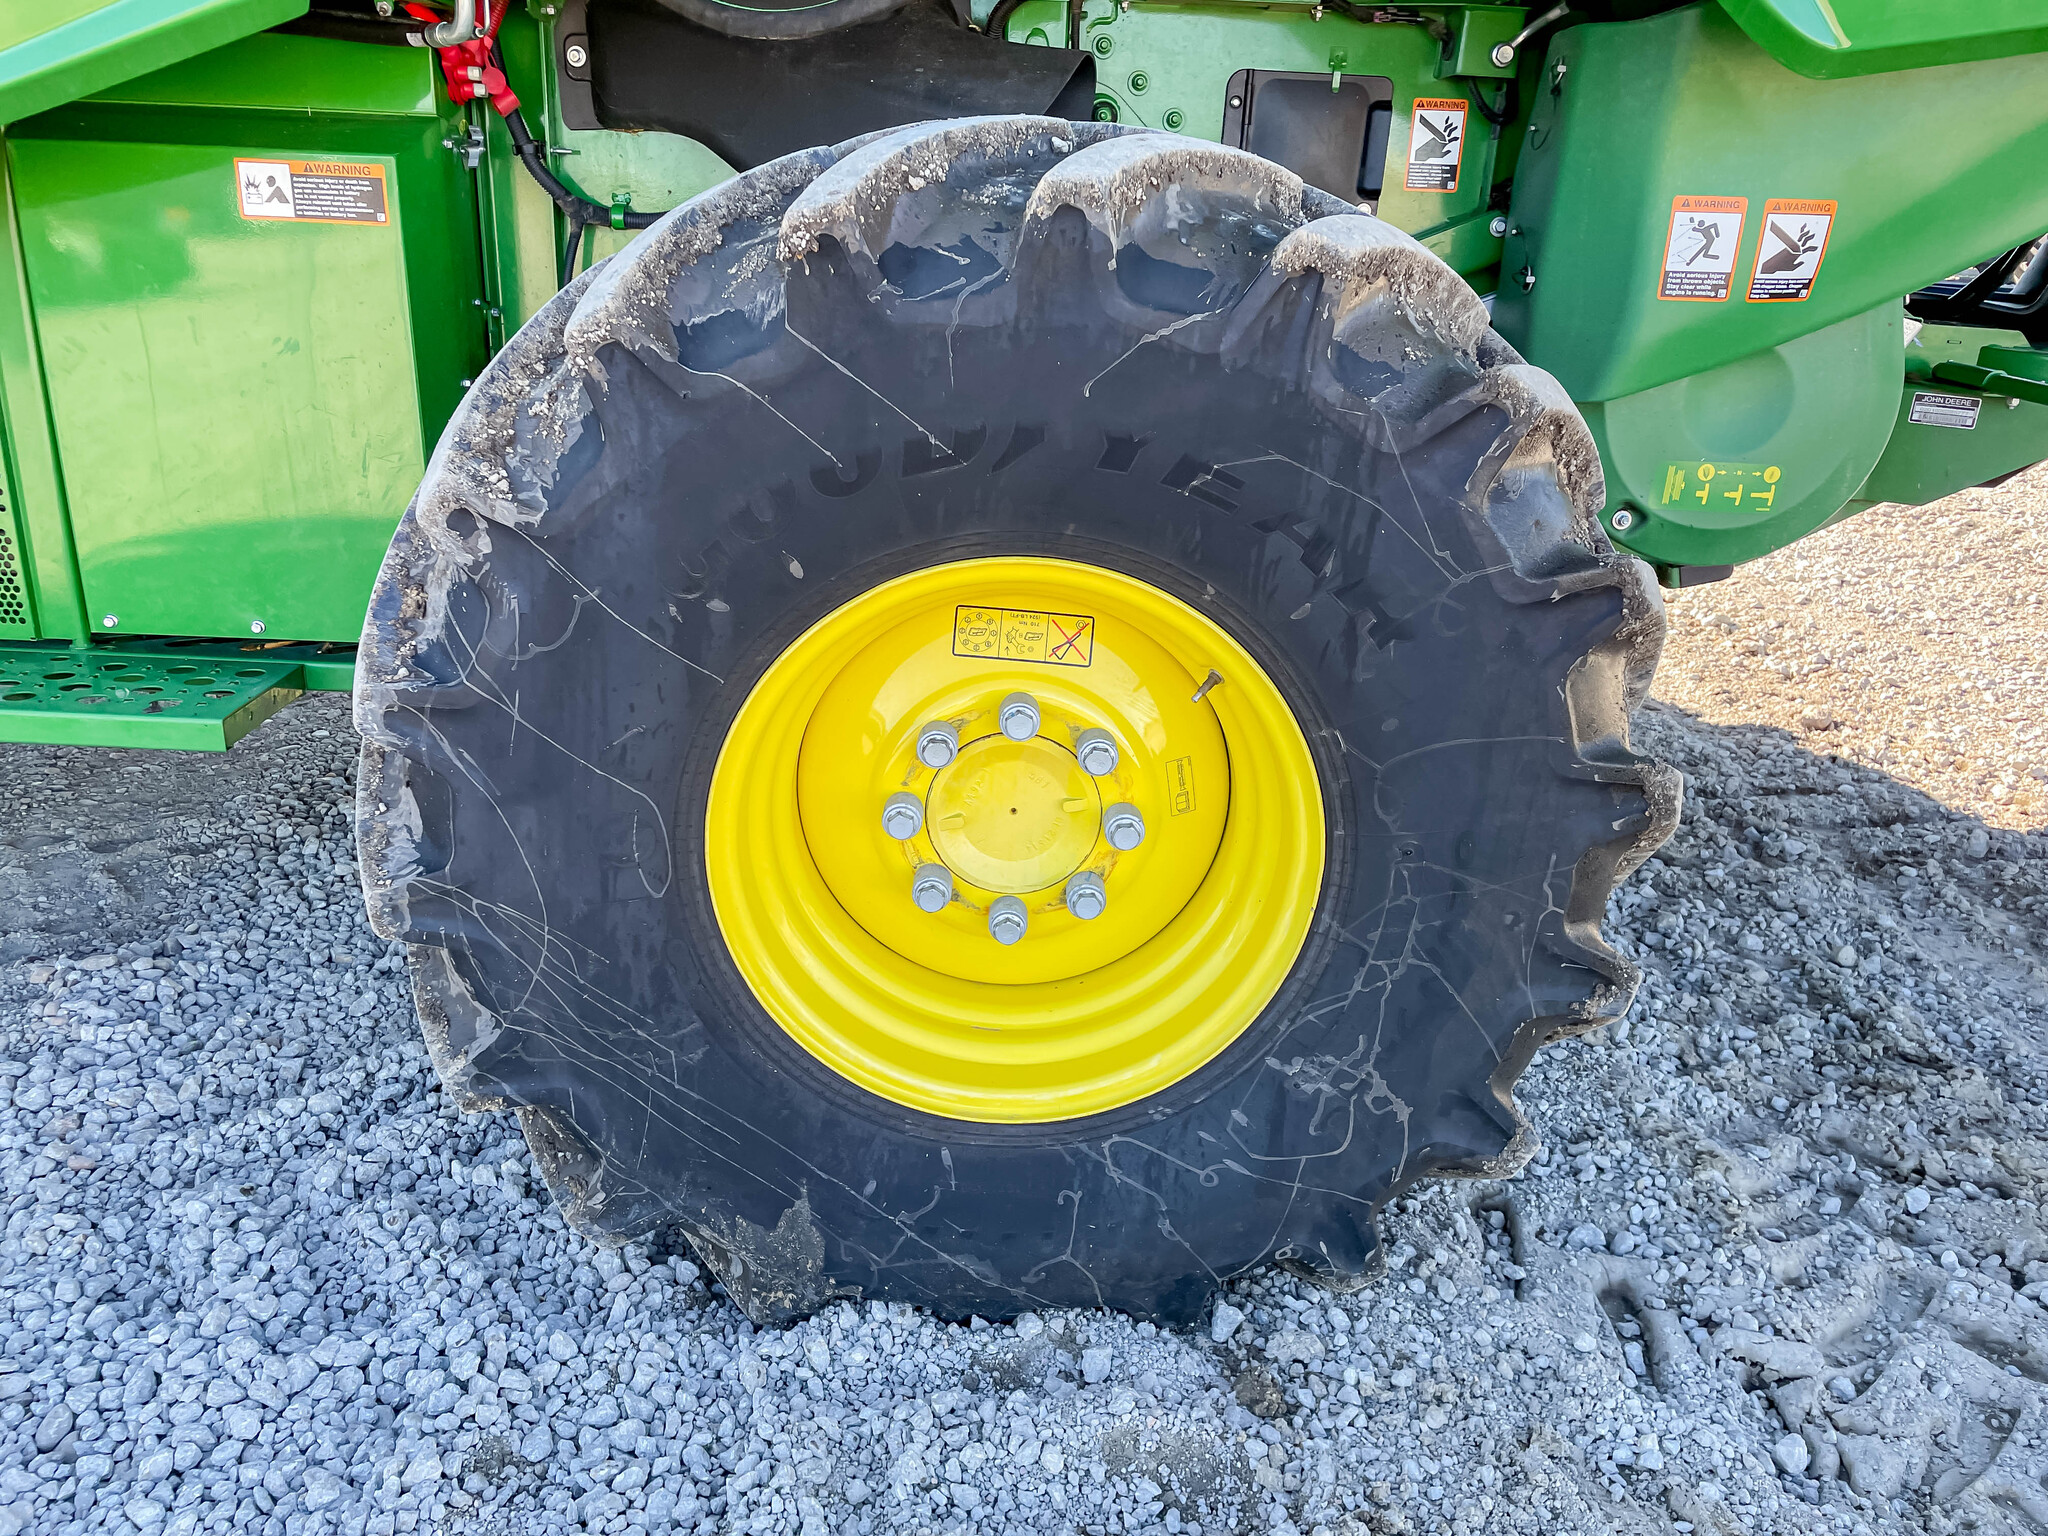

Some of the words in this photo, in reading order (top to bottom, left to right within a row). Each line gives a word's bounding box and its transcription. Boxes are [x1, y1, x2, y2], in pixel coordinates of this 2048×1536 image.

[1426, 101, 1465, 109] WARNING
[313, 164, 371, 175] WARNING
[1694, 200, 1740, 209] WARNING
[1784, 203, 1831, 212] WARNING
[1945, 398, 1972, 406] DEERE
